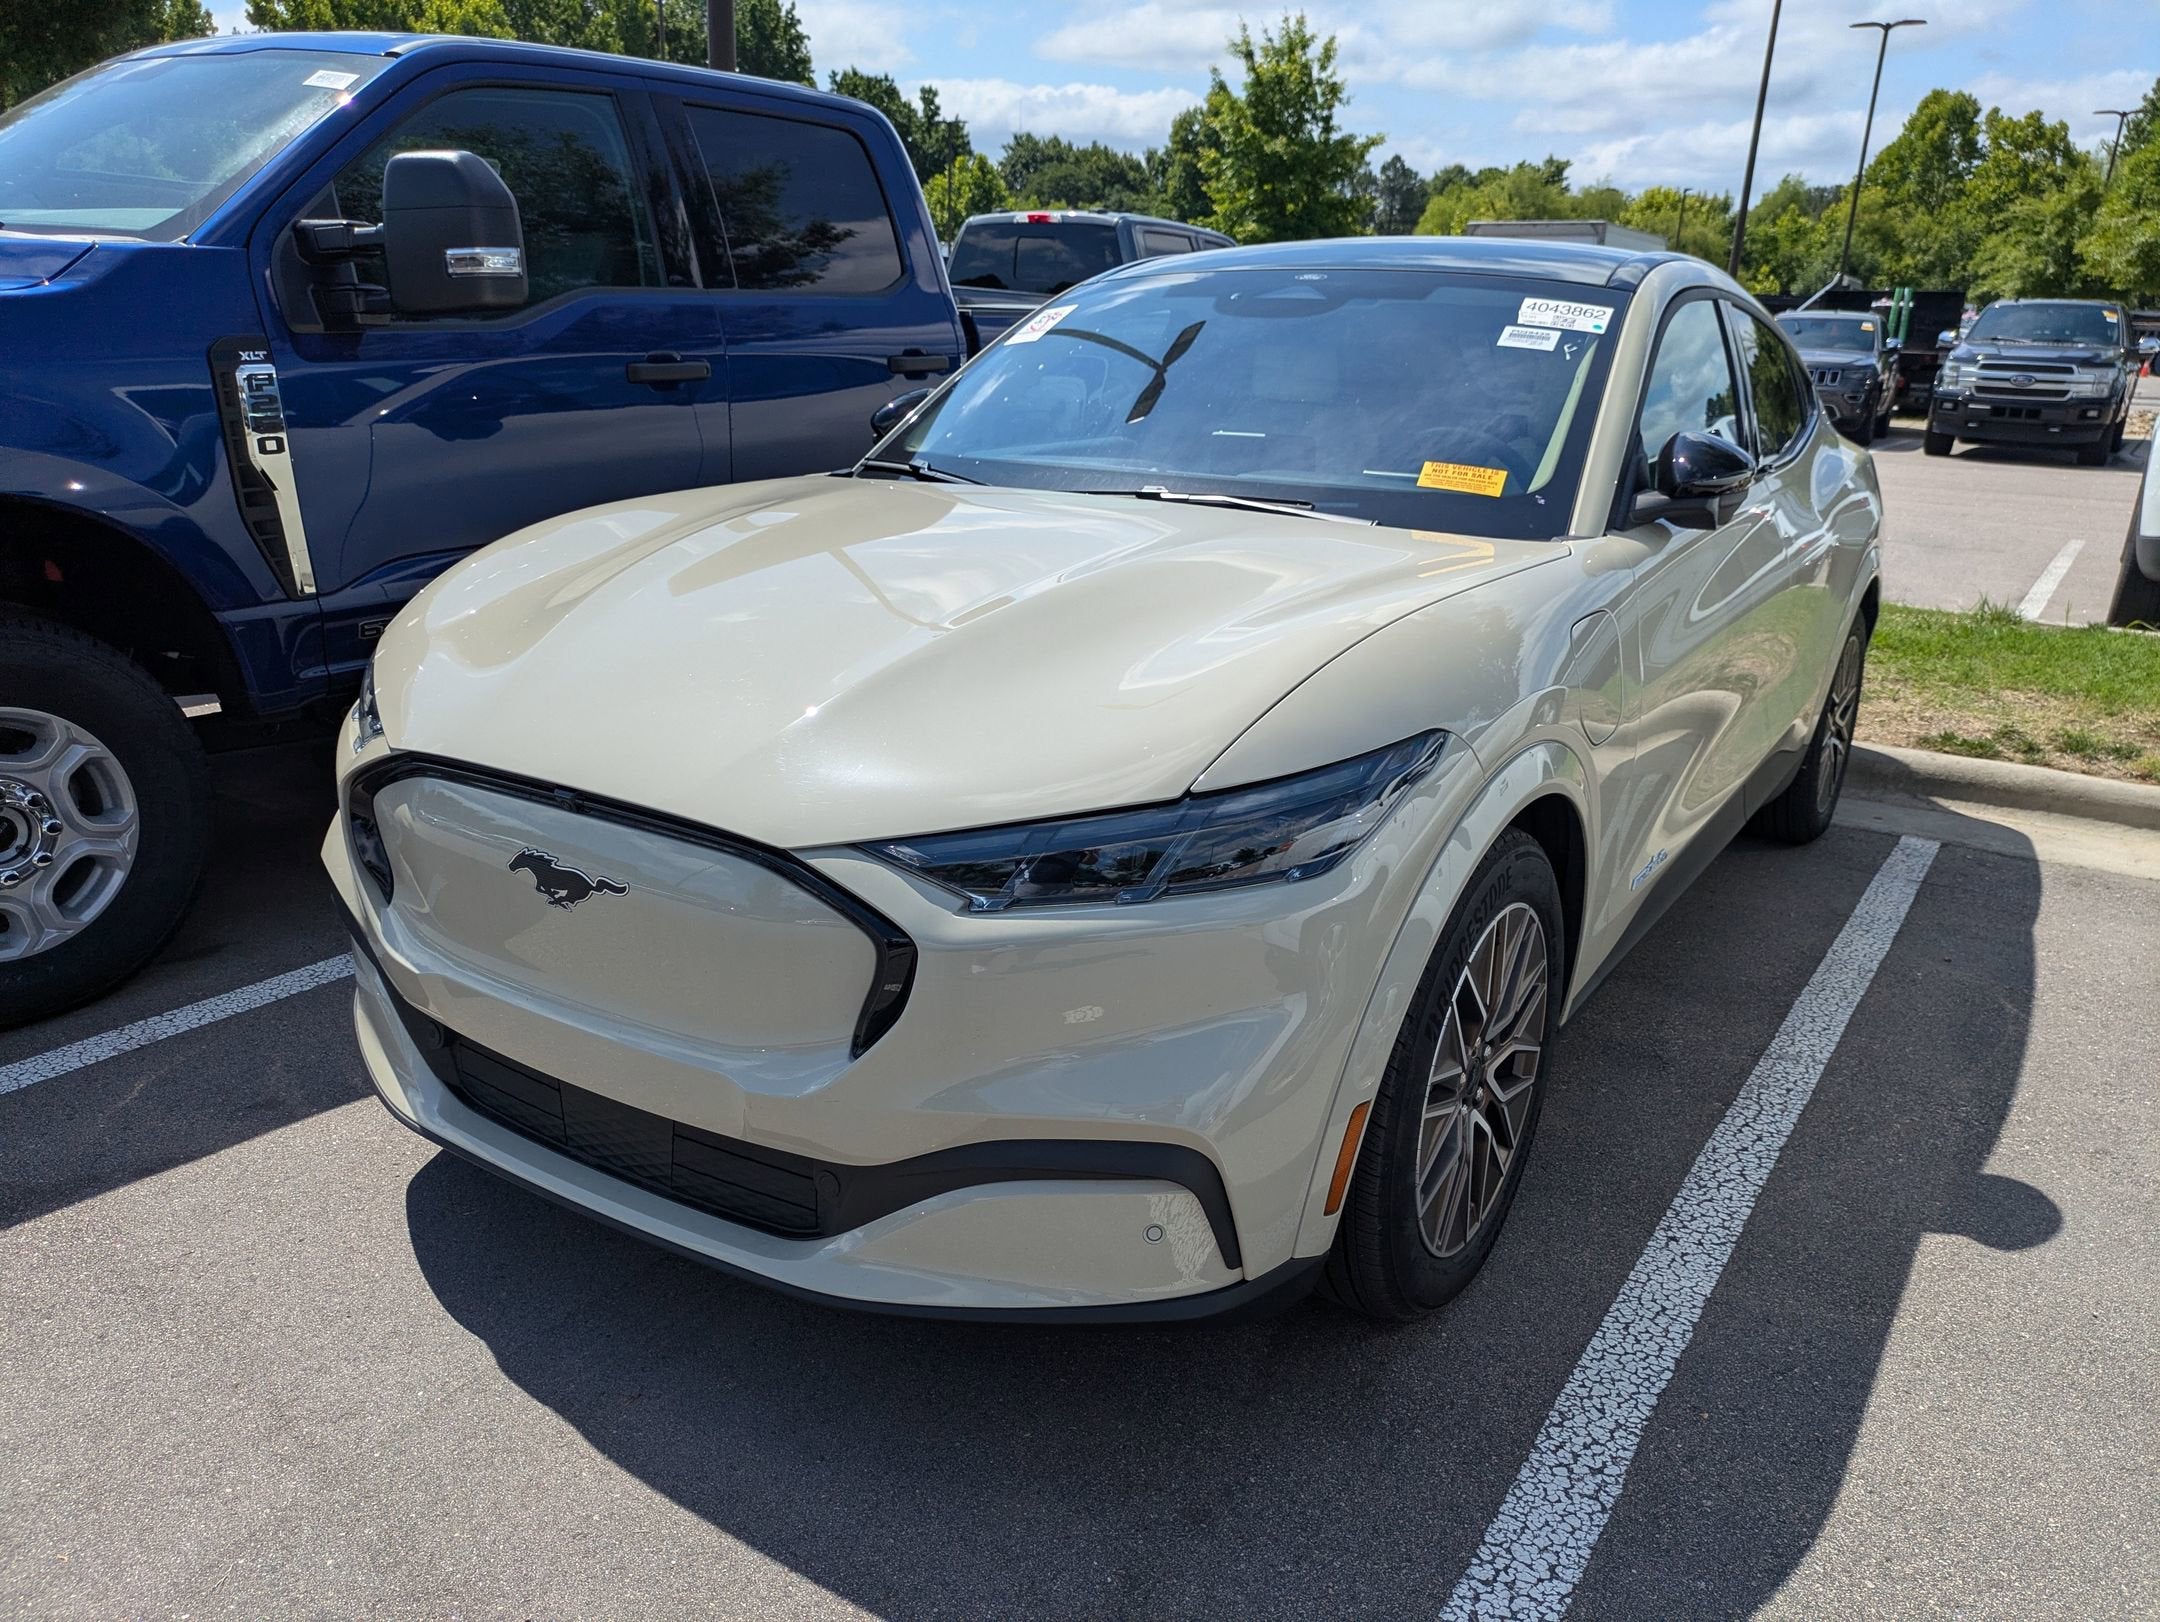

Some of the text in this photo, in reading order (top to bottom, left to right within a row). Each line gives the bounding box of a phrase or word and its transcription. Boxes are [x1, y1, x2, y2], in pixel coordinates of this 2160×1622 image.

[1526, 302, 1606, 320] 4043862
[238, 350, 268, 361] XLT
[1453, 465, 1488, 473] VEHICLE
